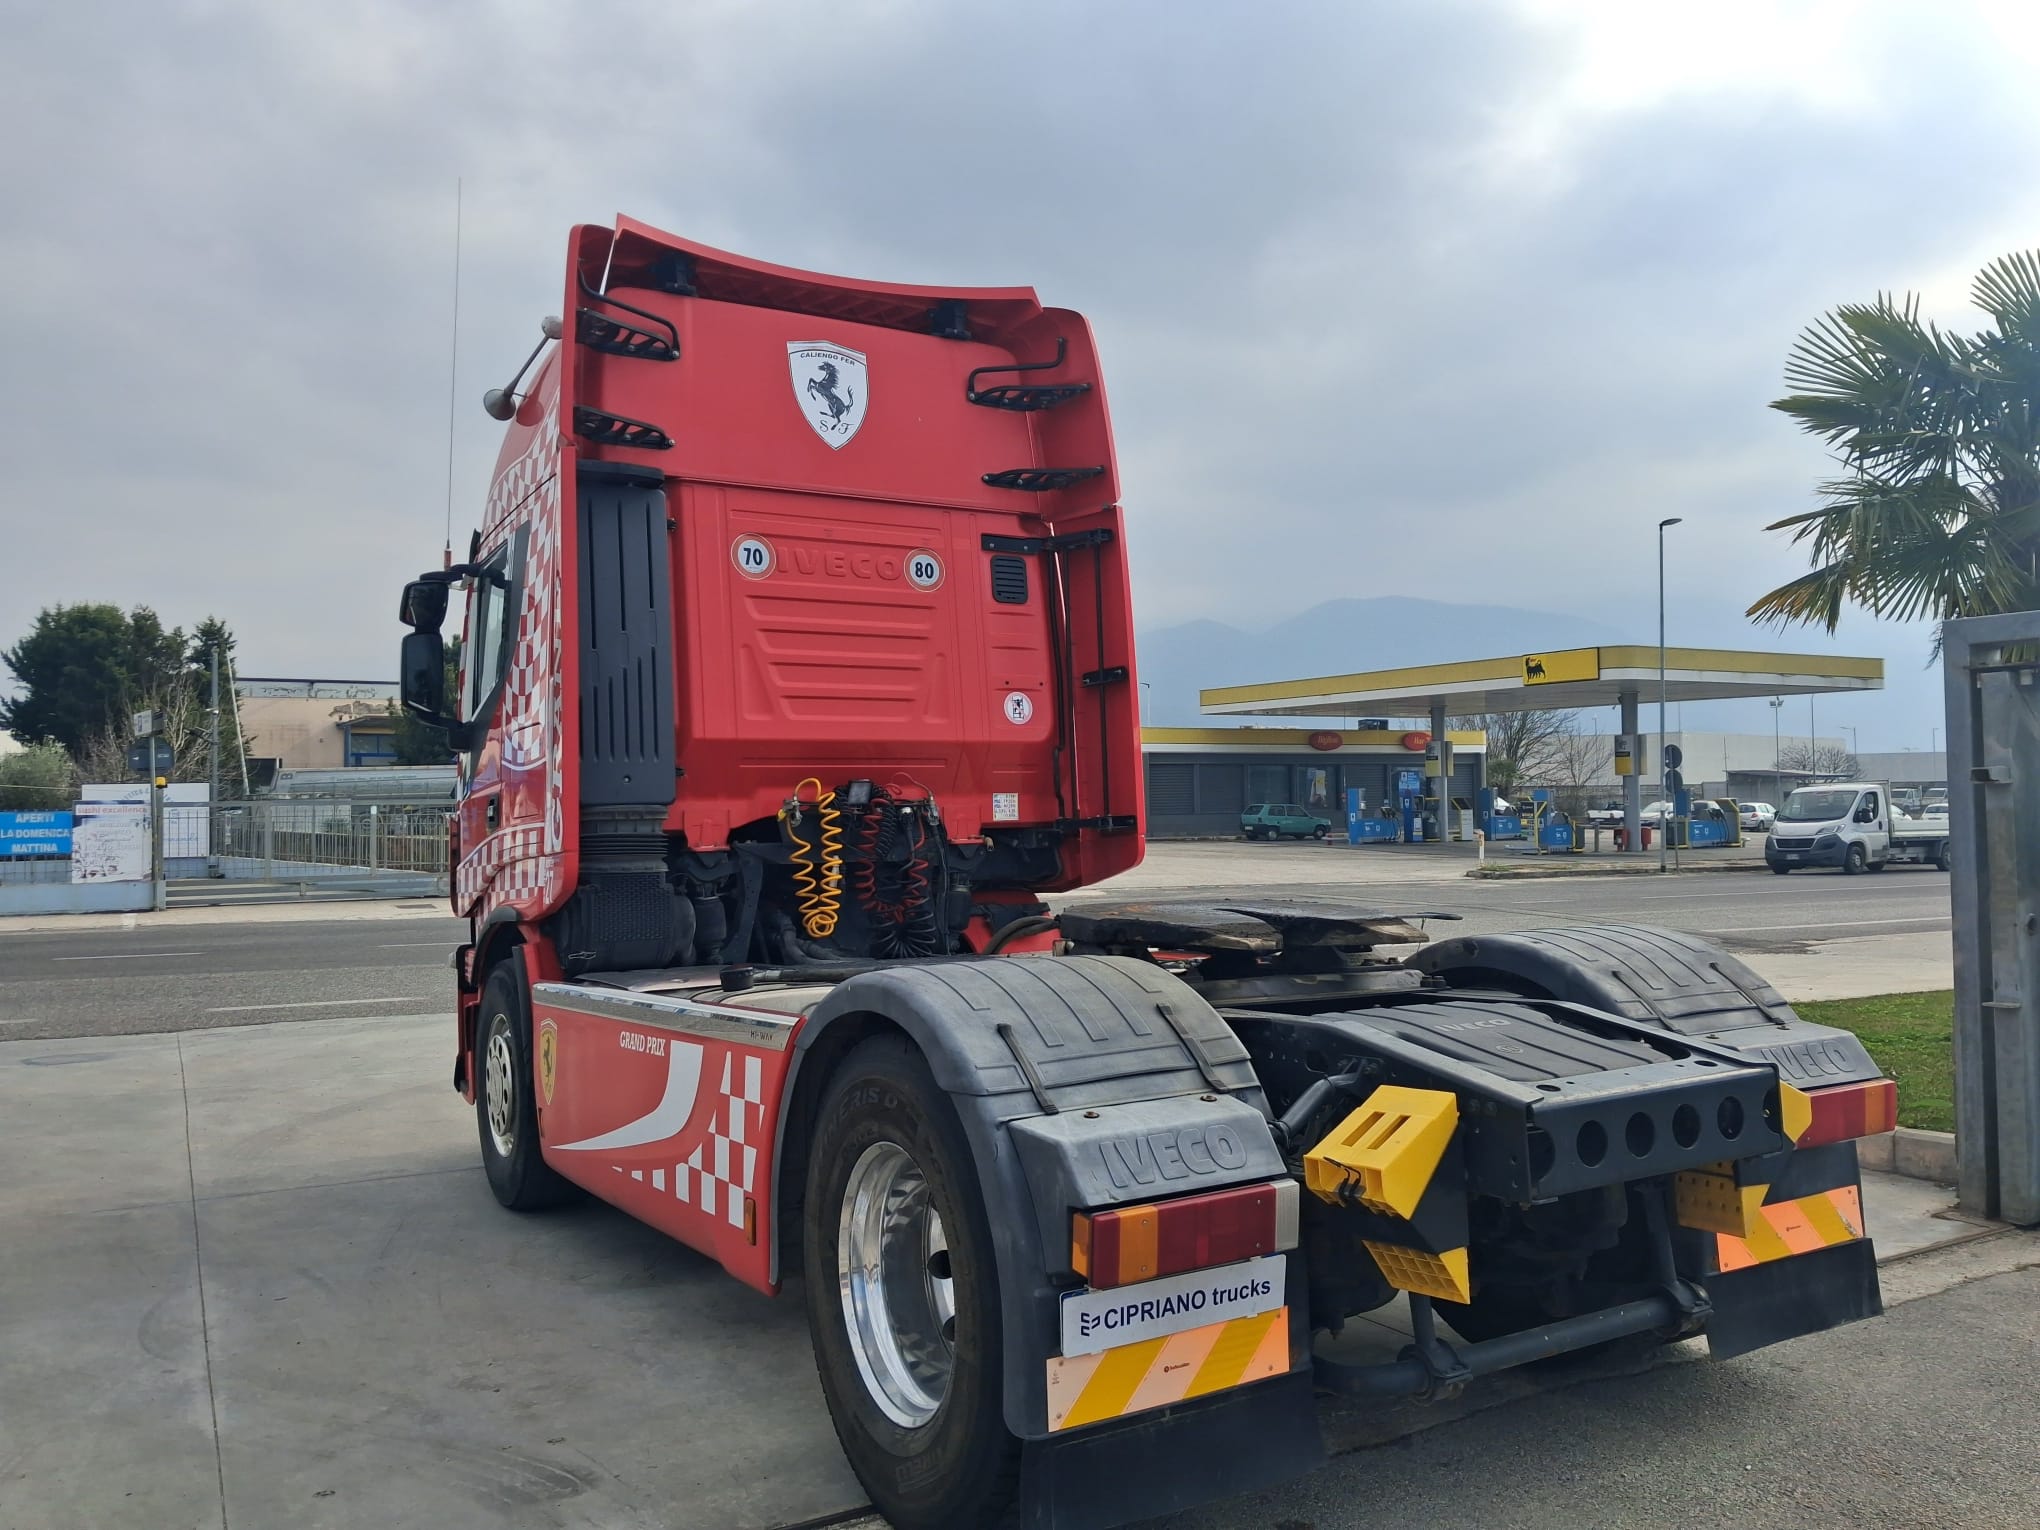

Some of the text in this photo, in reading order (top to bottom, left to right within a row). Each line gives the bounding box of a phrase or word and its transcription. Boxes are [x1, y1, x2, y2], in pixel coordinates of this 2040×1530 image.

[743, 547, 763, 566] 70
[776, 546, 902, 581] IVECO
[914, 561, 934, 579] 80
[15, 813, 55, 823] APERTI
[77, 805, 100, 814] sushi
[0, 829, 71, 838] LA DOMENICA
[11, 843, 58, 852] MATTINA
[1434, 1019, 1512, 1032] IVECO
[620, 1031, 666, 1057] GRAND PRIX
[1760, 1041, 1857, 1081] IVECO
[1099, 1124, 1247, 1188] IVECO
[1104, 1278, 1271, 1330] CIPRIANO trucks
